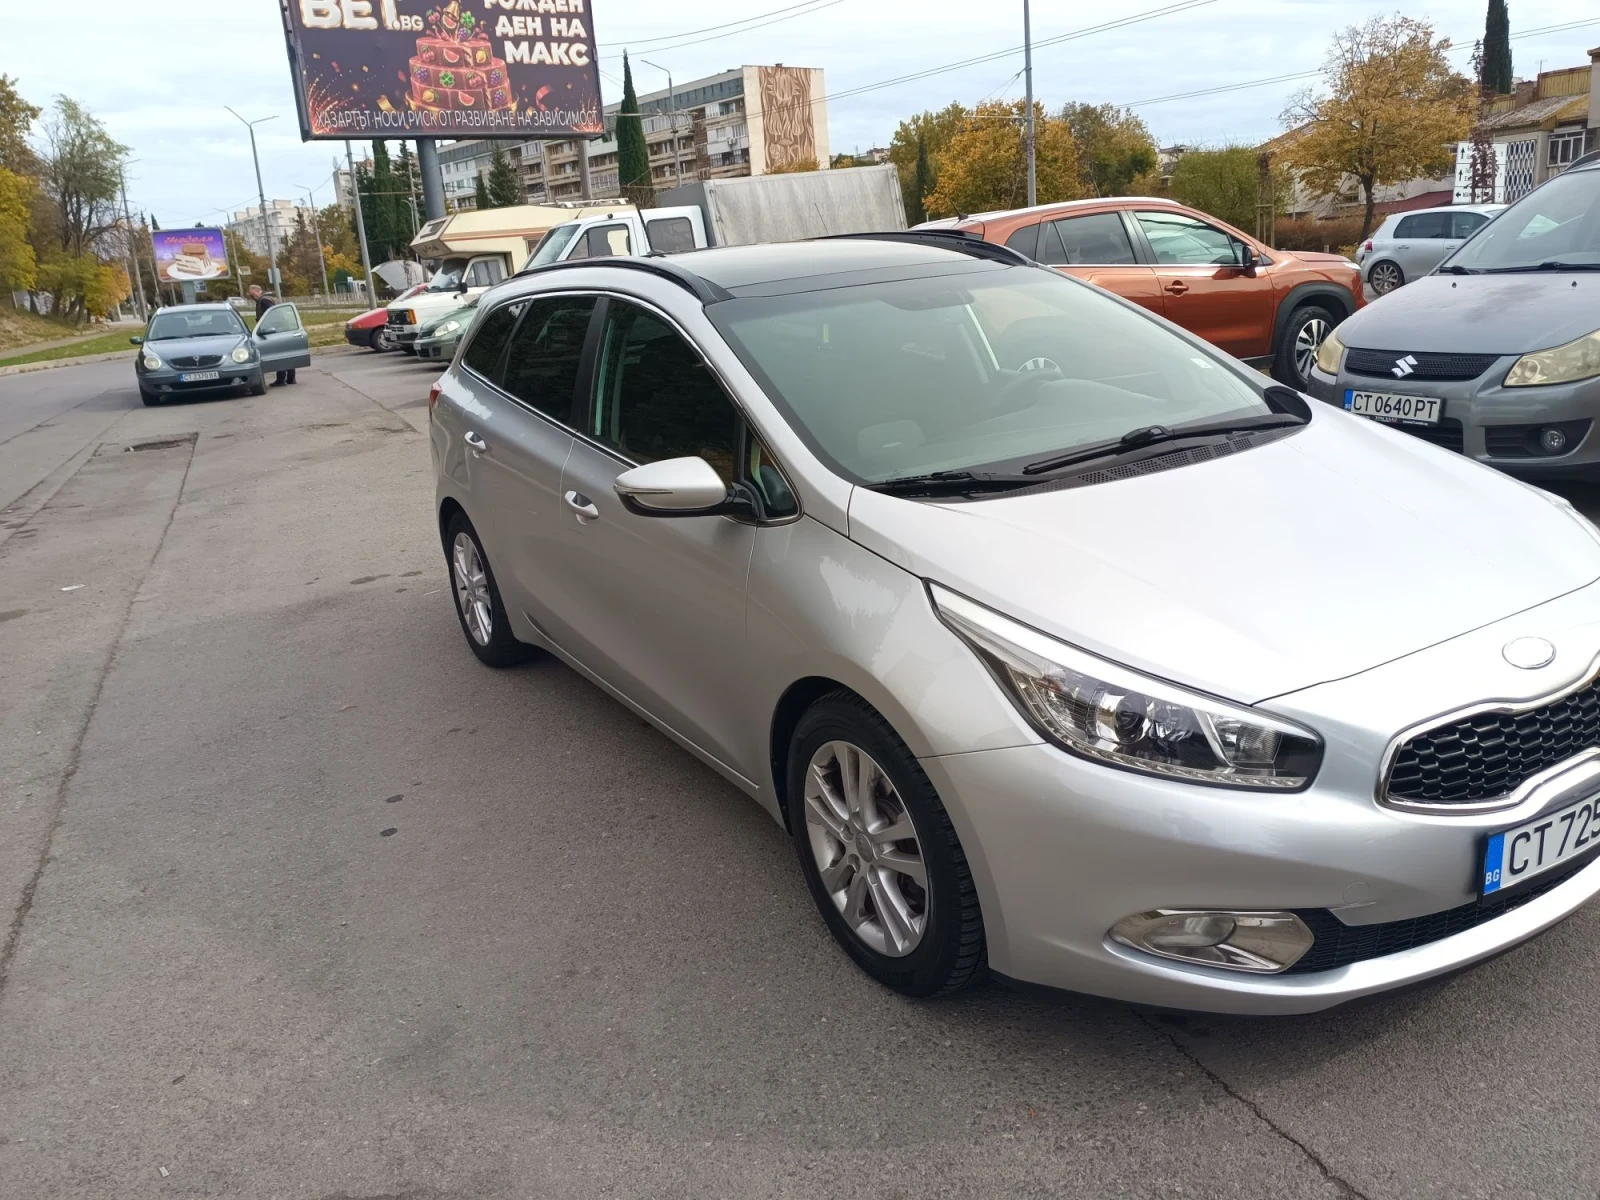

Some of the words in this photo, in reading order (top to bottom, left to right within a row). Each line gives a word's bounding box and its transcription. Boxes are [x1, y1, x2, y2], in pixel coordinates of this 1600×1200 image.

[495, 15, 543, 37] ДЕН
[550, 17, 587, 38] НА
[504, 40, 590, 66] МАКС
[316, 110, 370, 127] ХАЗАРТЪТ
[374, 110, 405, 128] НОСИ
[408, 110, 438, 127] РИСК
[439, 110, 452, 127] ОТ
[454, 110, 516, 126] РАЗВИВАНЕ
[517, 110, 532, 126] НА
[533, 110, 597, 126] ЗАВИСИМОСТ
[1353, 394, 1373, 412] CT
[1375, 396, 1412, 416] 0640
[1414, 399, 1437, 419] PT
[1485, 869, 1500, 885] BG
[1509, 821, 1553, 876] CT
